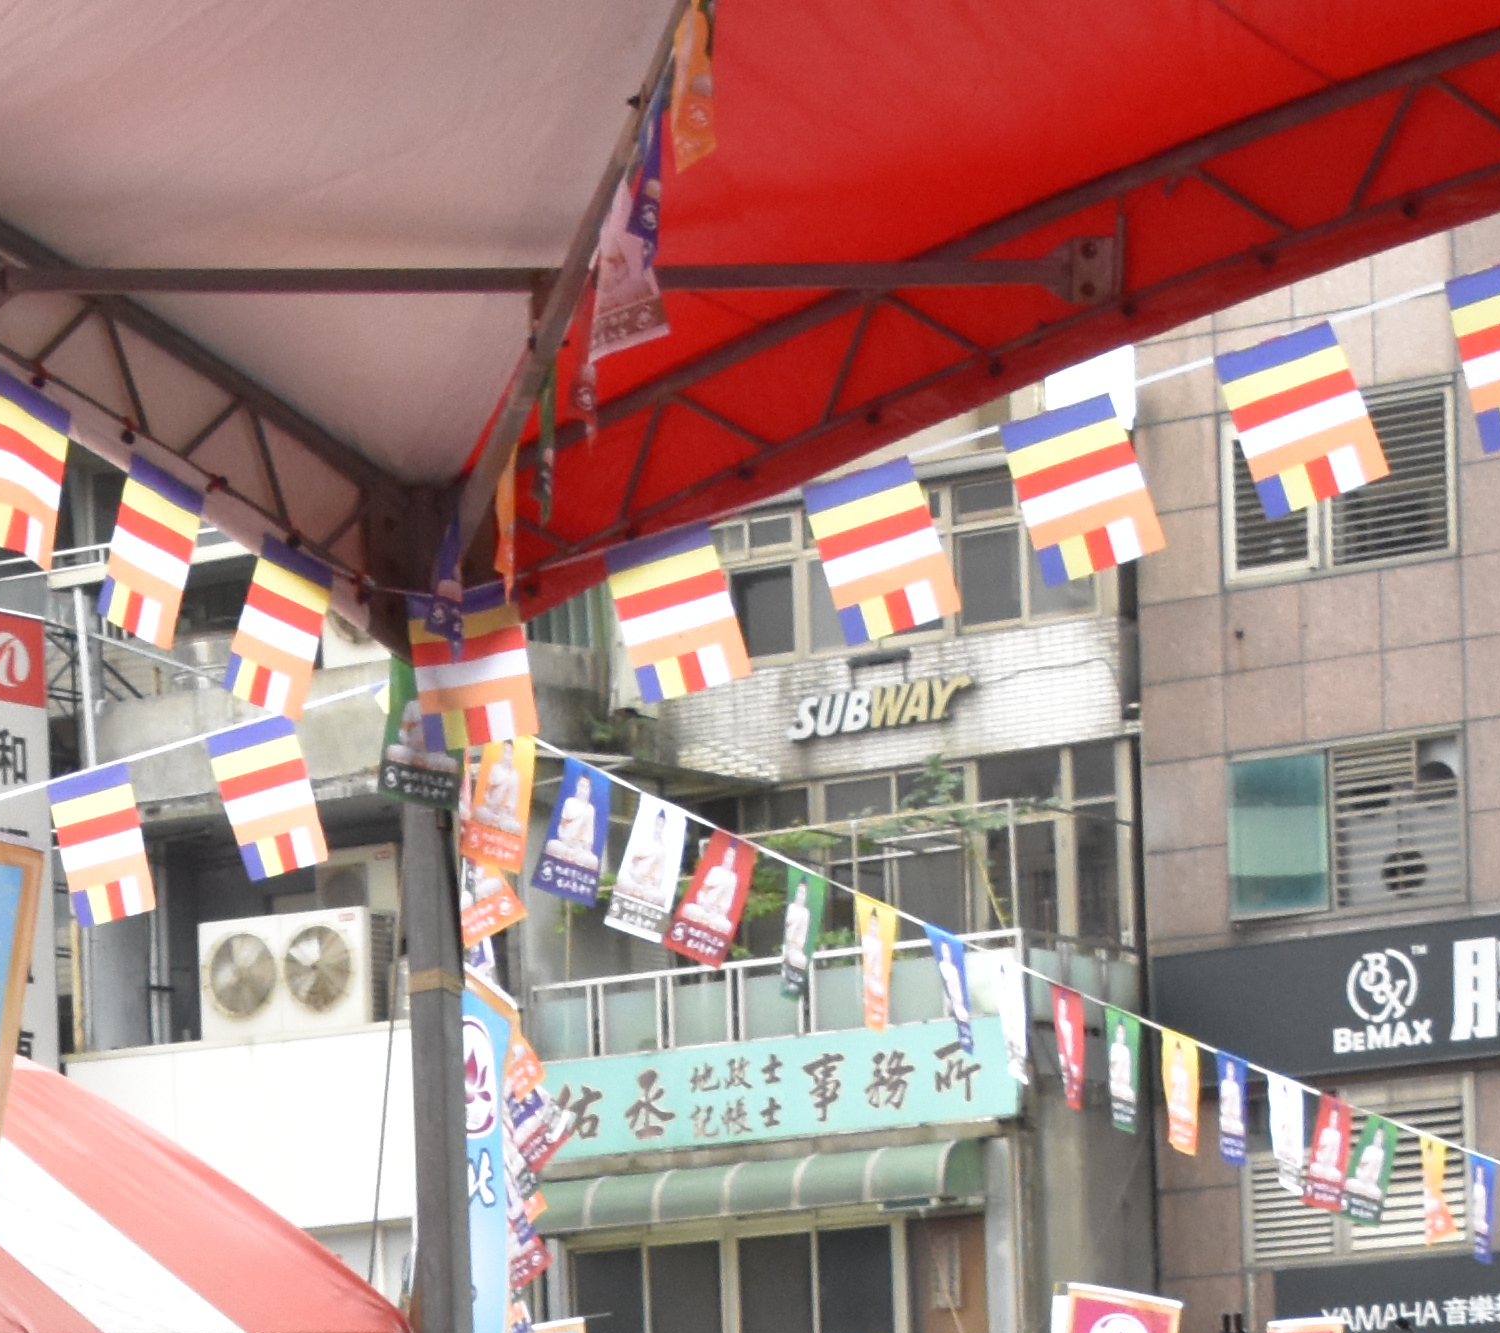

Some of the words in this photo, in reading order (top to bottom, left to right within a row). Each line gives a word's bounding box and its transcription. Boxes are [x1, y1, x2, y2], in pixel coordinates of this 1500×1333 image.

[785, 673, 973, 741] SUBWAY
[689, 1052, 785, 1094] 地政士
[802, 1040, 982, 1123] 事務所
